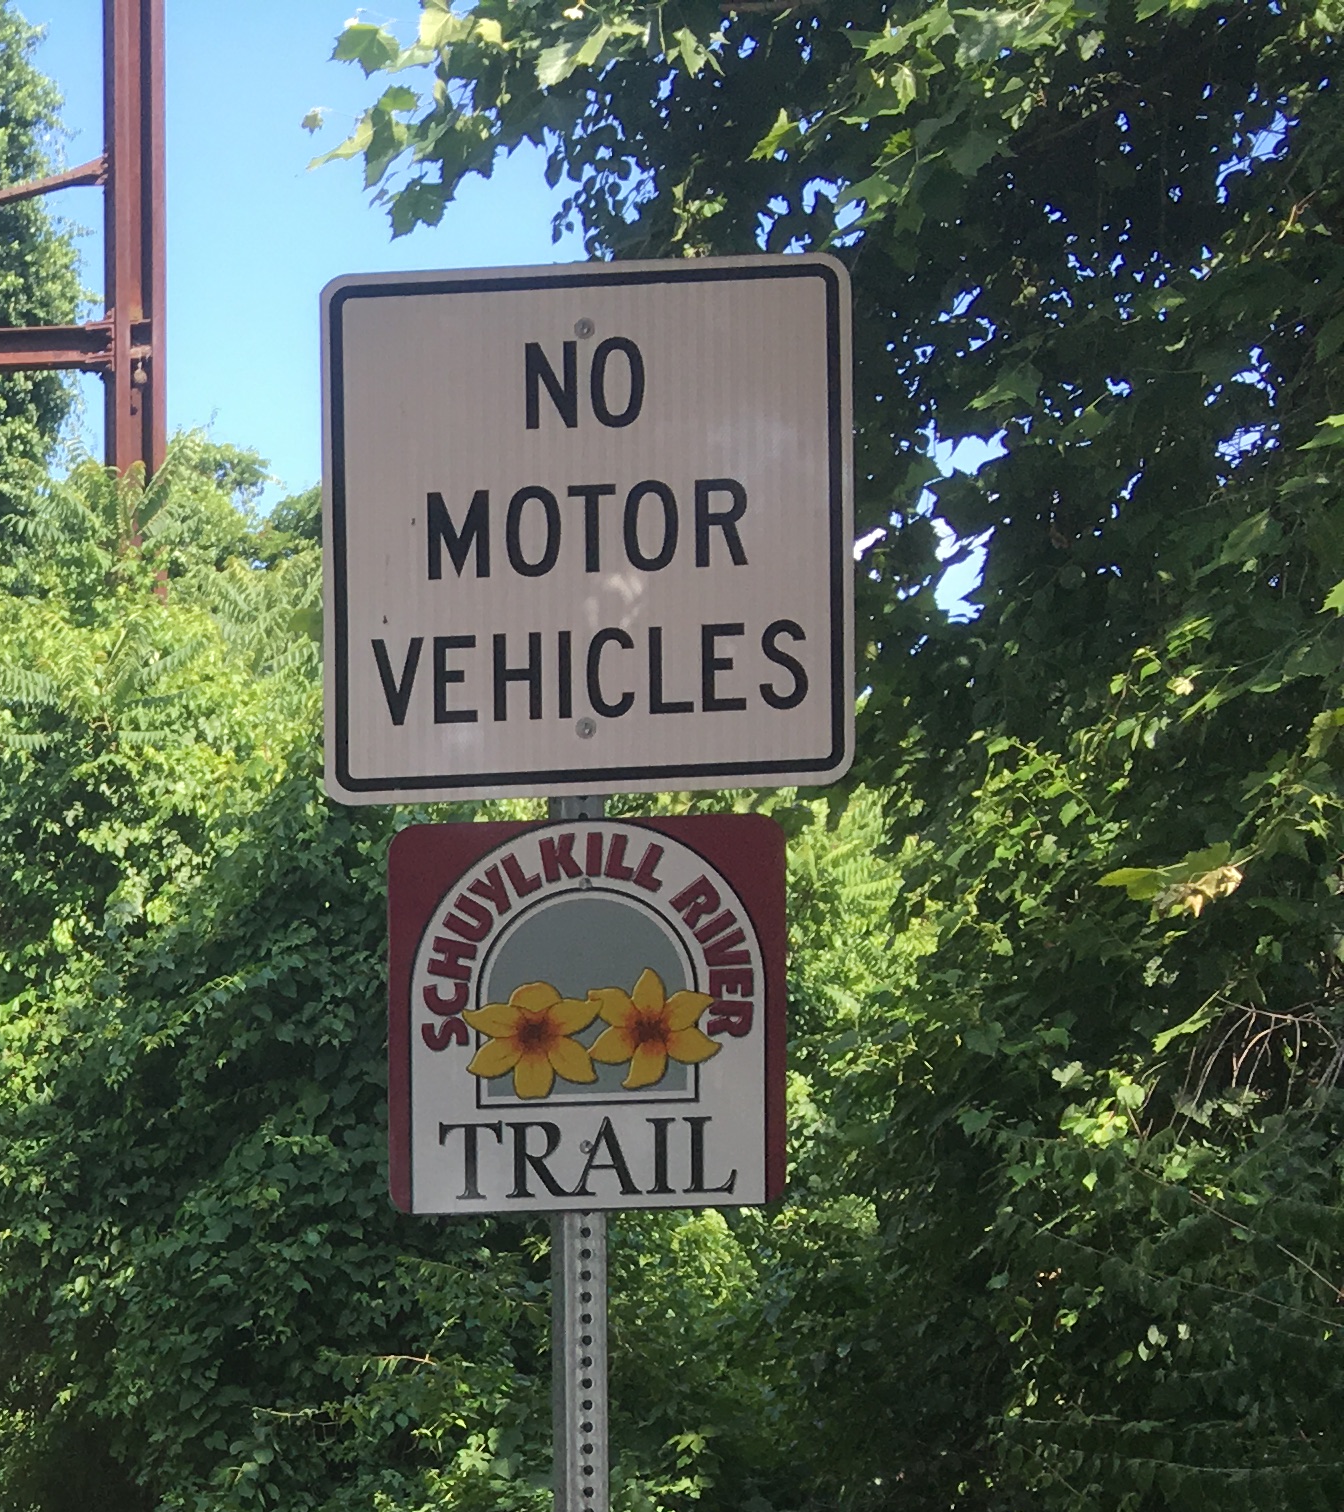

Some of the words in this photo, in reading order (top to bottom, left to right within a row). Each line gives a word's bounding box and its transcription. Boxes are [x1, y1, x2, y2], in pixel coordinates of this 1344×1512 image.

[525, 336, 645, 430] NO
[426, 478, 749, 581] MOTOR
[370, 619, 809, 727] VEHICLES
[421, 831, 665, 1052] SCHUYLKILL
[669, 874, 755, 1038] RIVER
[438, 1115, 738, 1200] TRAIL
